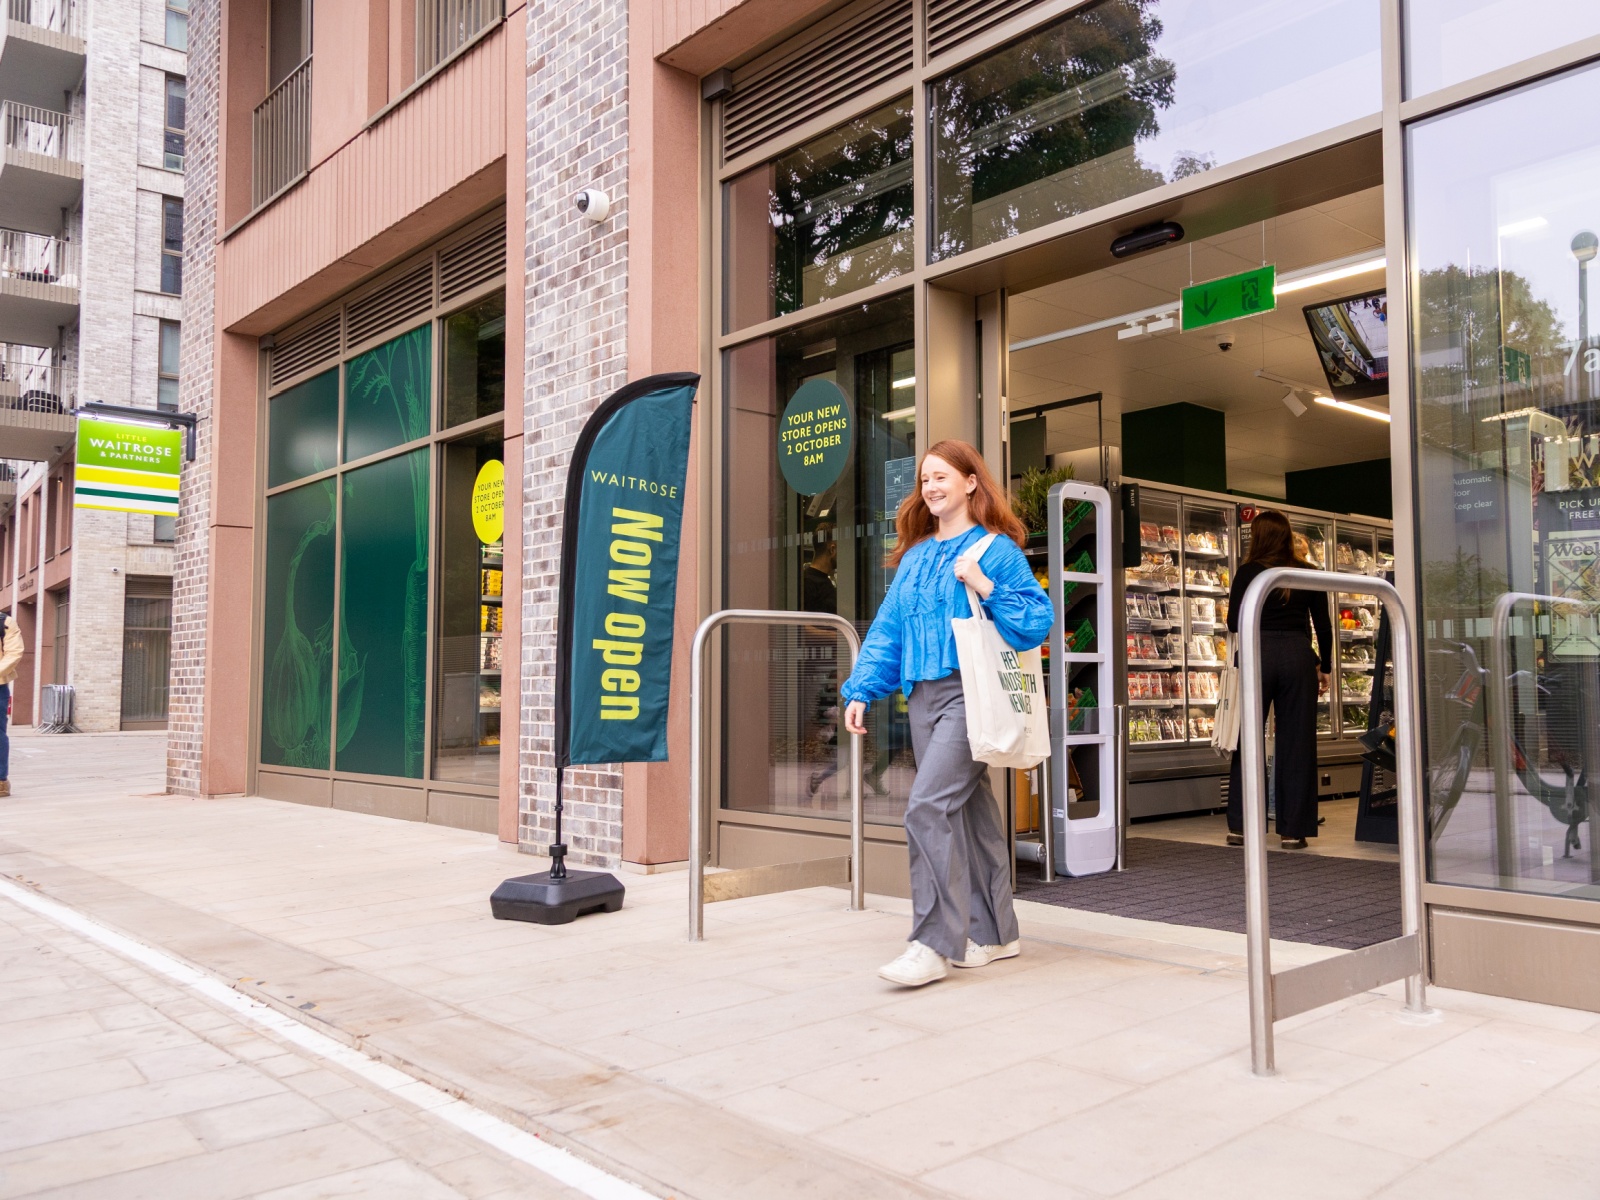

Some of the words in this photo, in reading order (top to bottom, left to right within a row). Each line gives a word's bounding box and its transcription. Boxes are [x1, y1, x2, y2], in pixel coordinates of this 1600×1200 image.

[788, 411, 814, 426] YOUR
[817, 404, 840, 420] NEW
[782, 426, 811, 442] STORE
[814, 417, 847, 435] OPENS
[116, 433, 147, 443] LITTLE
[89, 437, 172, 457] WAITROSE
[787, 445, 792, 455] 2
[795, 434, 841, 453] OCTOBER
[110, 452, 160, 464] PARTNERS
[803, 452, 824, 466] 8AM
[591, 470, 678, 499] WAITROSE
[1453, 475, 1492, 486] Automatic
[477, 482, 492, 492] YOUR
[474, 493, 490, 503] STORE
[480, 501, 504, 513] OCTOBER
[1454, 502, 1472, 511] Keep
[1474, 500, 1493, 509] clear
[1559, 500, 1585, 510] PICK
[485, 513, 496, 522] 8AM
[1243, 509, 1252, 519] £7
[1569, 510, 1595, 520] FREE
[607, 507, 664, 604] Now
[592, 612, 647, 720] open
